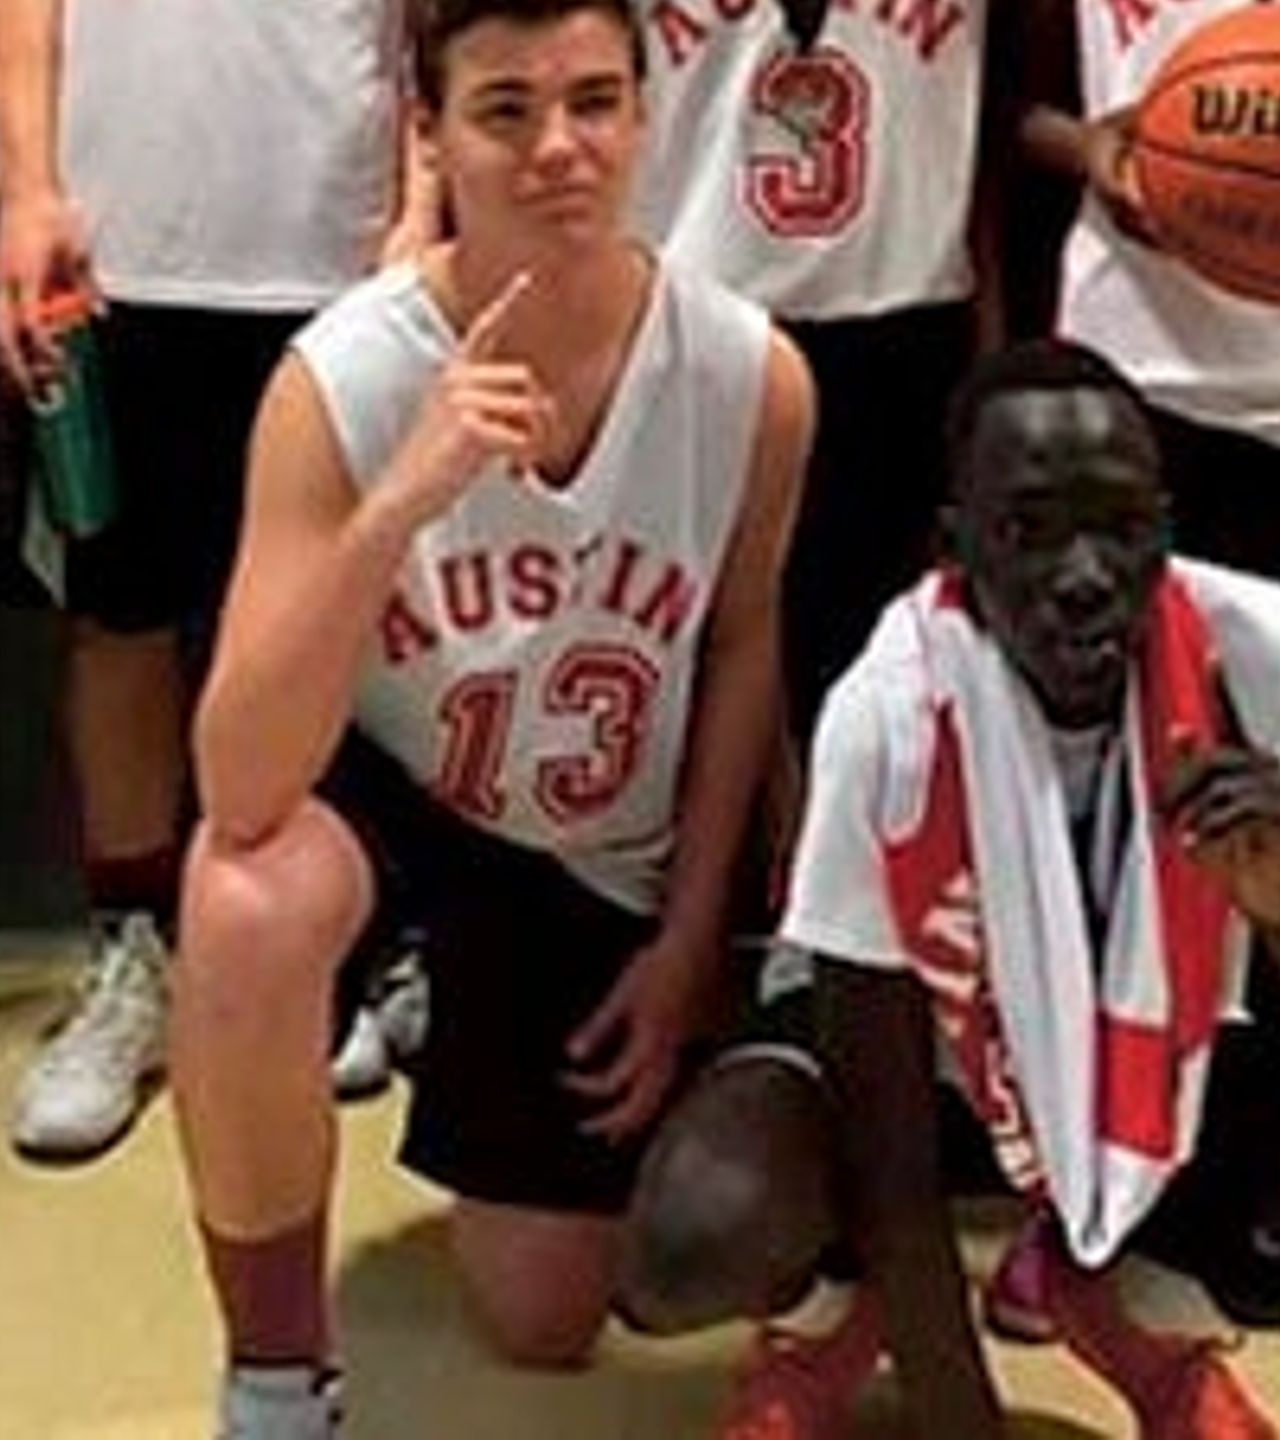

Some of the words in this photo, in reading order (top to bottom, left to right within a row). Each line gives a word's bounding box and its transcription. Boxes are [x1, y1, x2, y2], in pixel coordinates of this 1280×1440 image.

[744, 44, 870, 240] 3
[380, 534, 698, 665] AUSIN
[438, 640, 662, 826] 13
